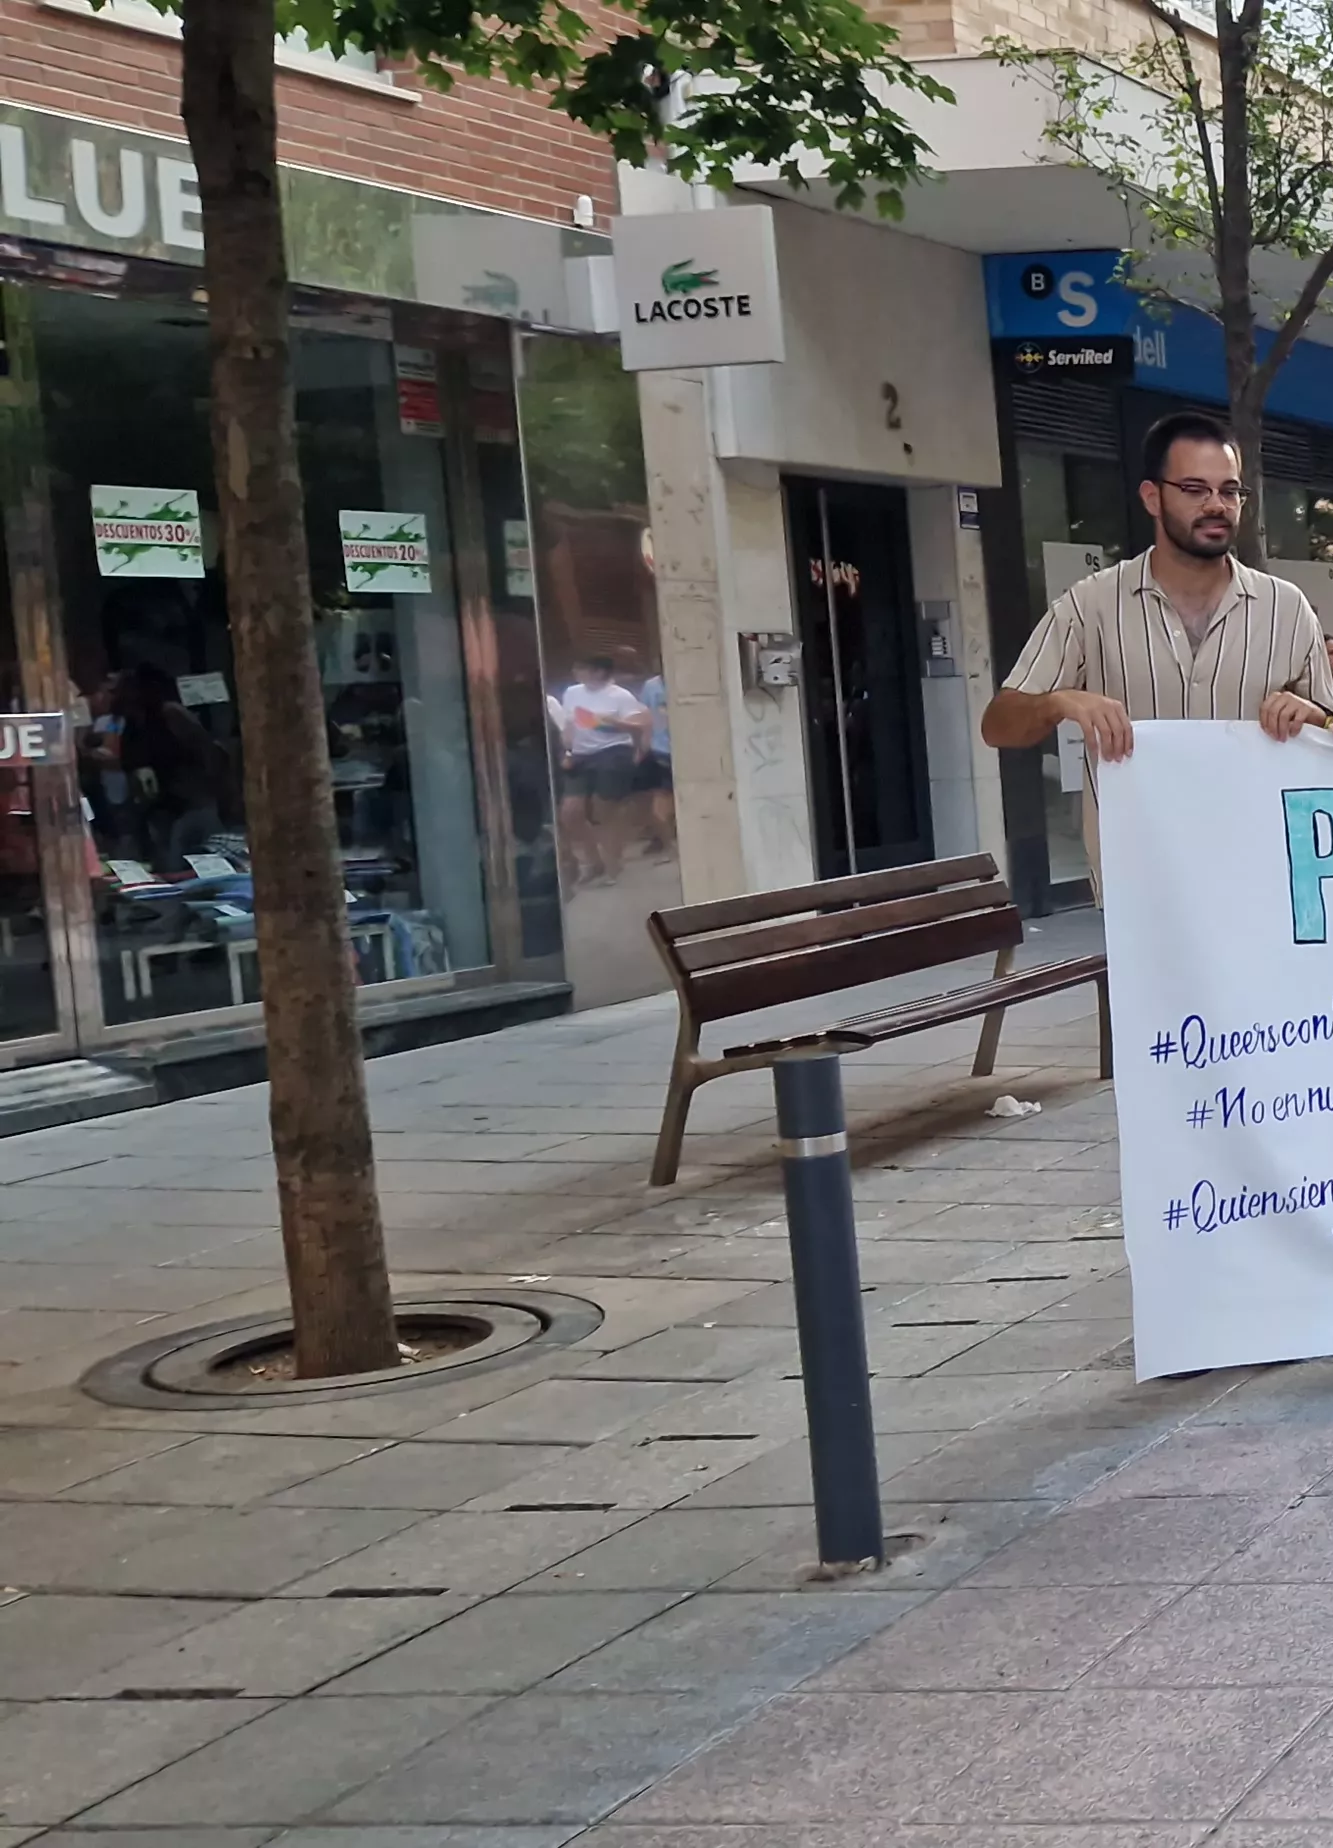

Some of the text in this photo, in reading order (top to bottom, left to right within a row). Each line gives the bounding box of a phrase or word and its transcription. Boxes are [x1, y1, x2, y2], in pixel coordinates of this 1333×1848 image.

[634, 294, 751, 324] LACOSTE
[1057, 271, 1098, 328] S
[1047, 348, 1113, 365] ServiRed
[881, 381, 902, 431] 2
[96, 523, 200, 543] DESCUENTOS 30%
[344, 545, 400, 560] DESCUENTOS
